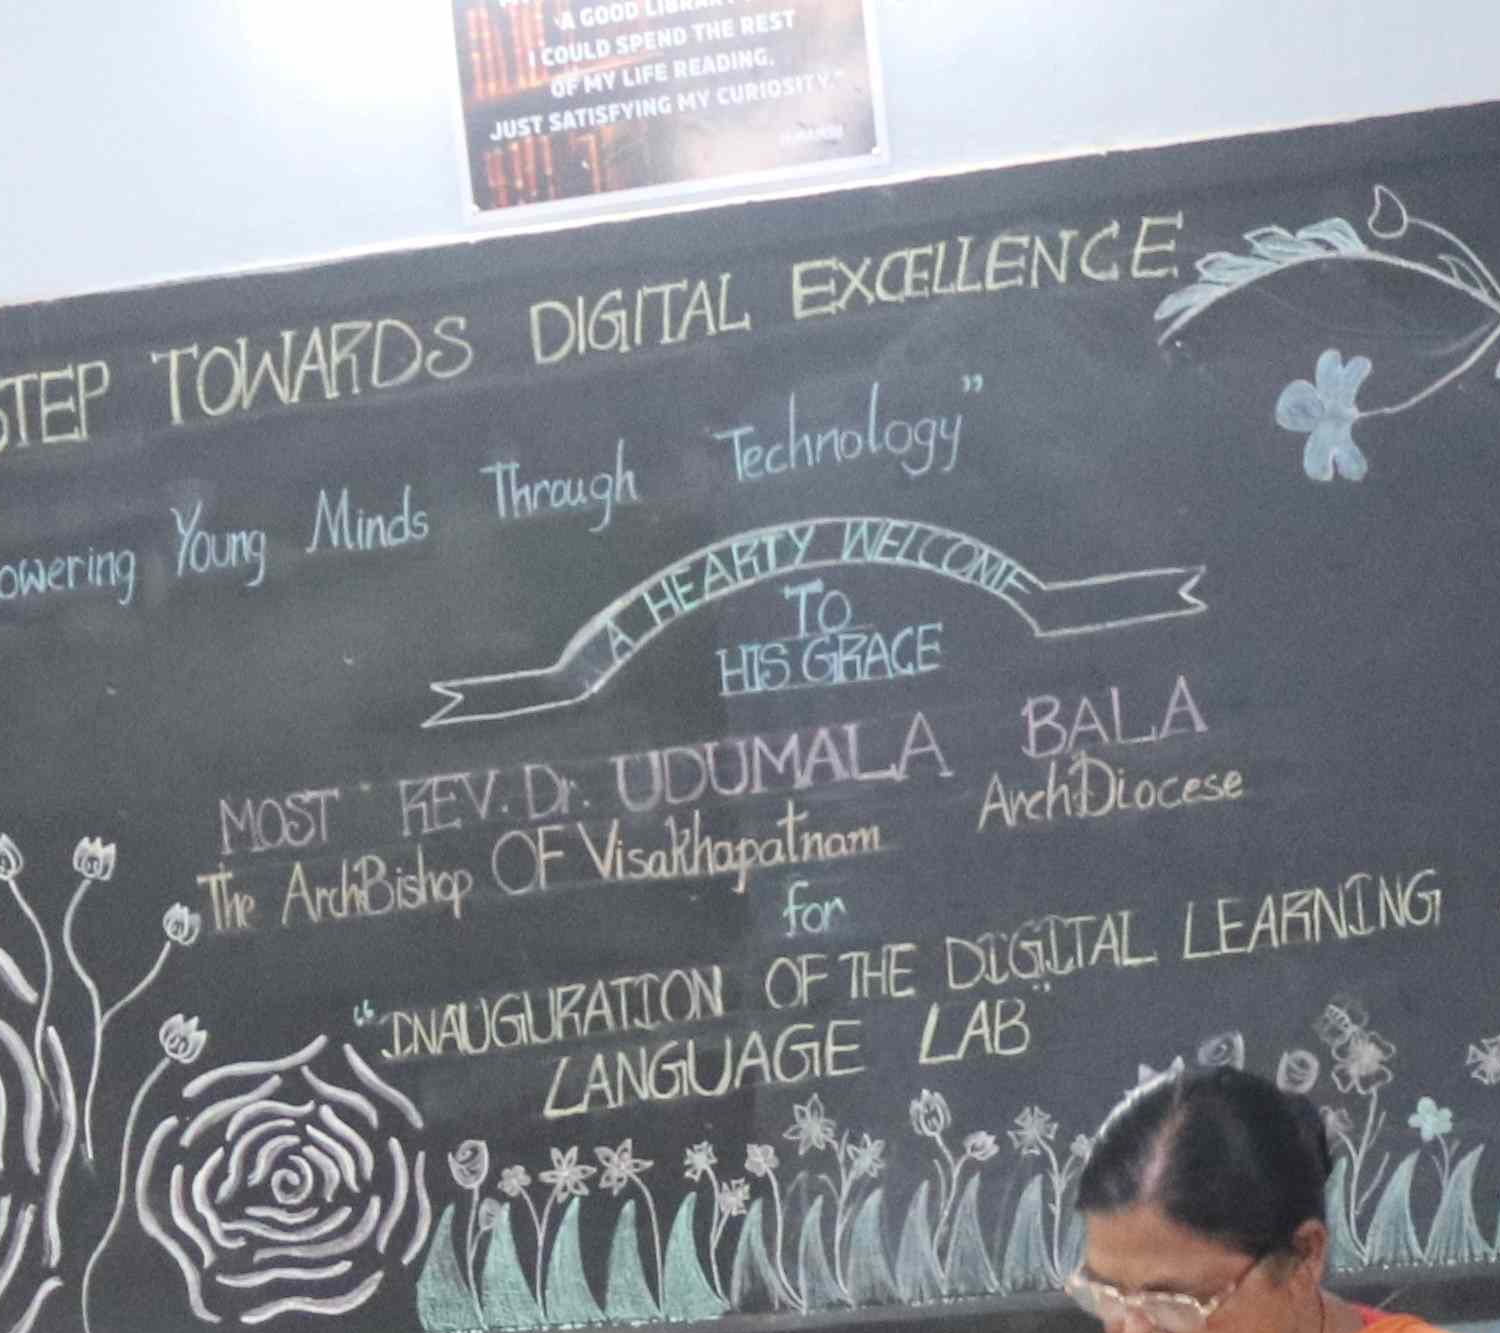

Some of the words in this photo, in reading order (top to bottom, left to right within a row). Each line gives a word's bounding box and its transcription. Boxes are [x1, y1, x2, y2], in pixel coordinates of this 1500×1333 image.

[528, 51, 537, 66] I
[541, 38, 611, 66] COULD
[616, 26, 687, 51] SPEND
[692, 18, 735, 42] THE
[740, 9, 796, 36] REST
[579, 1, 640, 28] GOOD
[489, 115, 545, 141] JUST
[549, 95, 672, 132] SATISFYING
[677, 88, 712, 113] MY
[551, 77, 580, 98] OF
[584, 69, 617, 94] MY
[621, 61, 668, 87] LIFE
[151, 316, 474, 425] TOWARDS
[530, 273, 752, 365] DIGITAL
[792, 211, 1185, 321] EXCELLENCE
[171, 501, 267, 588] Young
[305, 485, 430, 554] Minds
[480, 439, 640, 533] Through
[601, 617, 634, 662] A
[642, 524, 816, 627] HEARTY
[841, 519, 1034, 596] WELCOME
[784, 579, 853, 638] TO
[715, 643, 790, 694] HIS
[803, 622, 943, 684] GRACE
[220, 789, 339, 855] MOST
[1020, 675, 1208, 759] BALA
[197, 866, 255, 931] The
[492, 823, 565, 895] OF
[576, 801, 882, 895] Visakhapatnam
[978, 750, 1244, 833] ArchDiocese
[765, 954, 827, 1009] OF
[839, 944, 917, 998] THE
[945, 910, 1158, 990] DIGITAL
[1183, 870, 1441, 961] LEARNING
[783, 881, 845, 938] for
[543, 1020, 866, 1120] LANGUAGE
